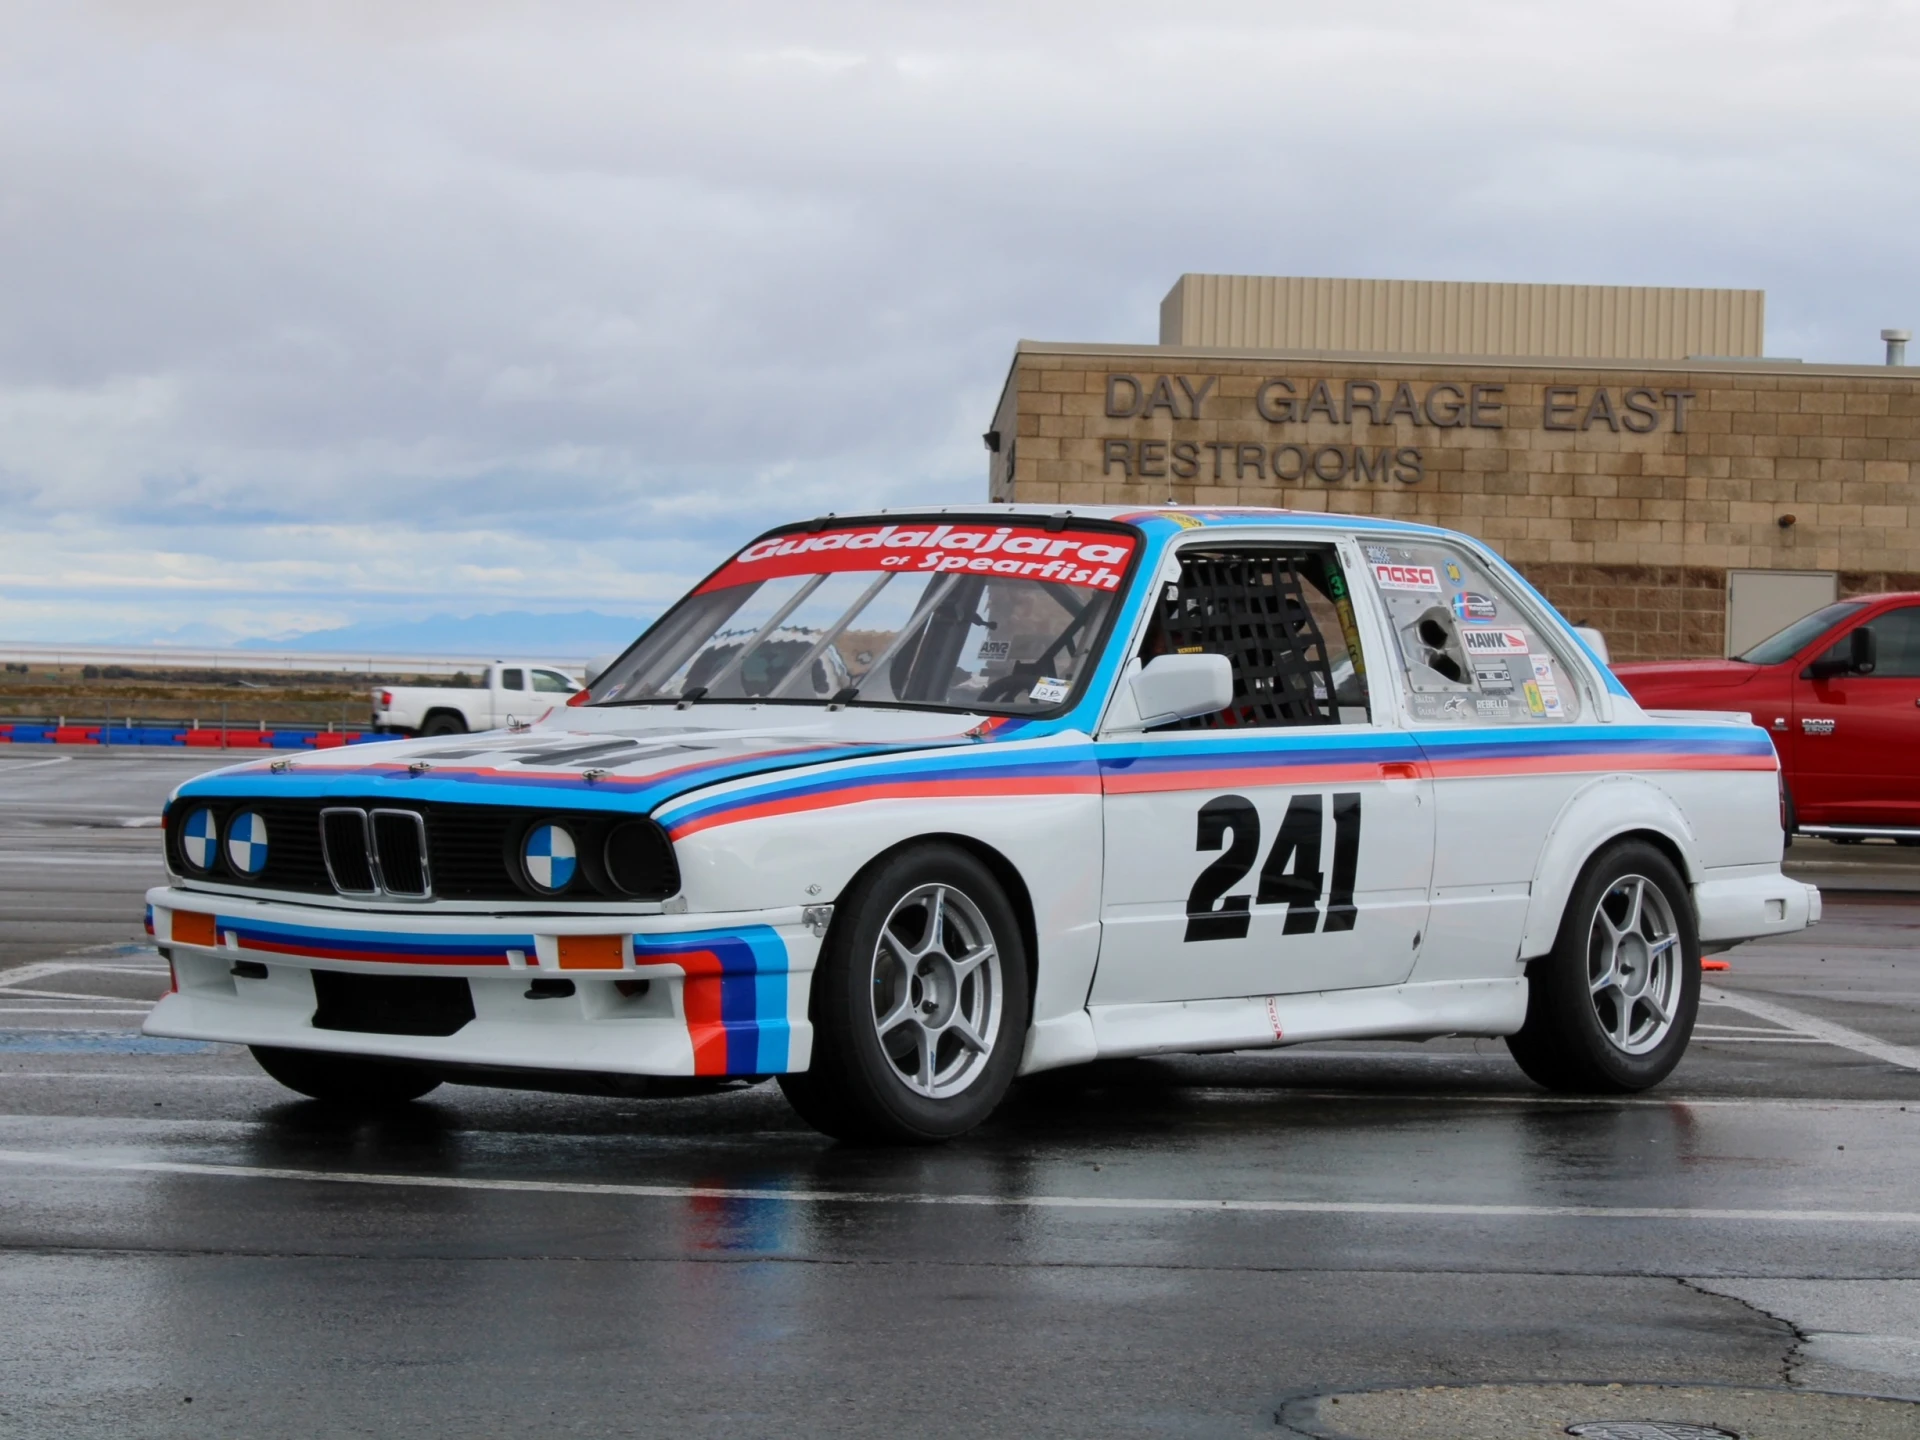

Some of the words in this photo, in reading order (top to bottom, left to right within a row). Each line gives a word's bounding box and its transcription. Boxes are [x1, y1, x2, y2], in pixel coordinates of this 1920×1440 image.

[1105, 373, 1216, 420] DAY
[1256, 378, 1505, 429] GARAGE
[1543, 385, 1696, 434] EAST
[1103, 438, 1425, 484] RESTROOMS
[737, 525, 1129, 564] Guadalajara
[918, 551, 1120, 588] Spearfish
[1464, 632, 1507, 649] HAWK
[1476, 699, 1509, 709] REBELLO
[1184, 792, 1361, 942] 241
[1267, 998, 1281, 1030] JACK
